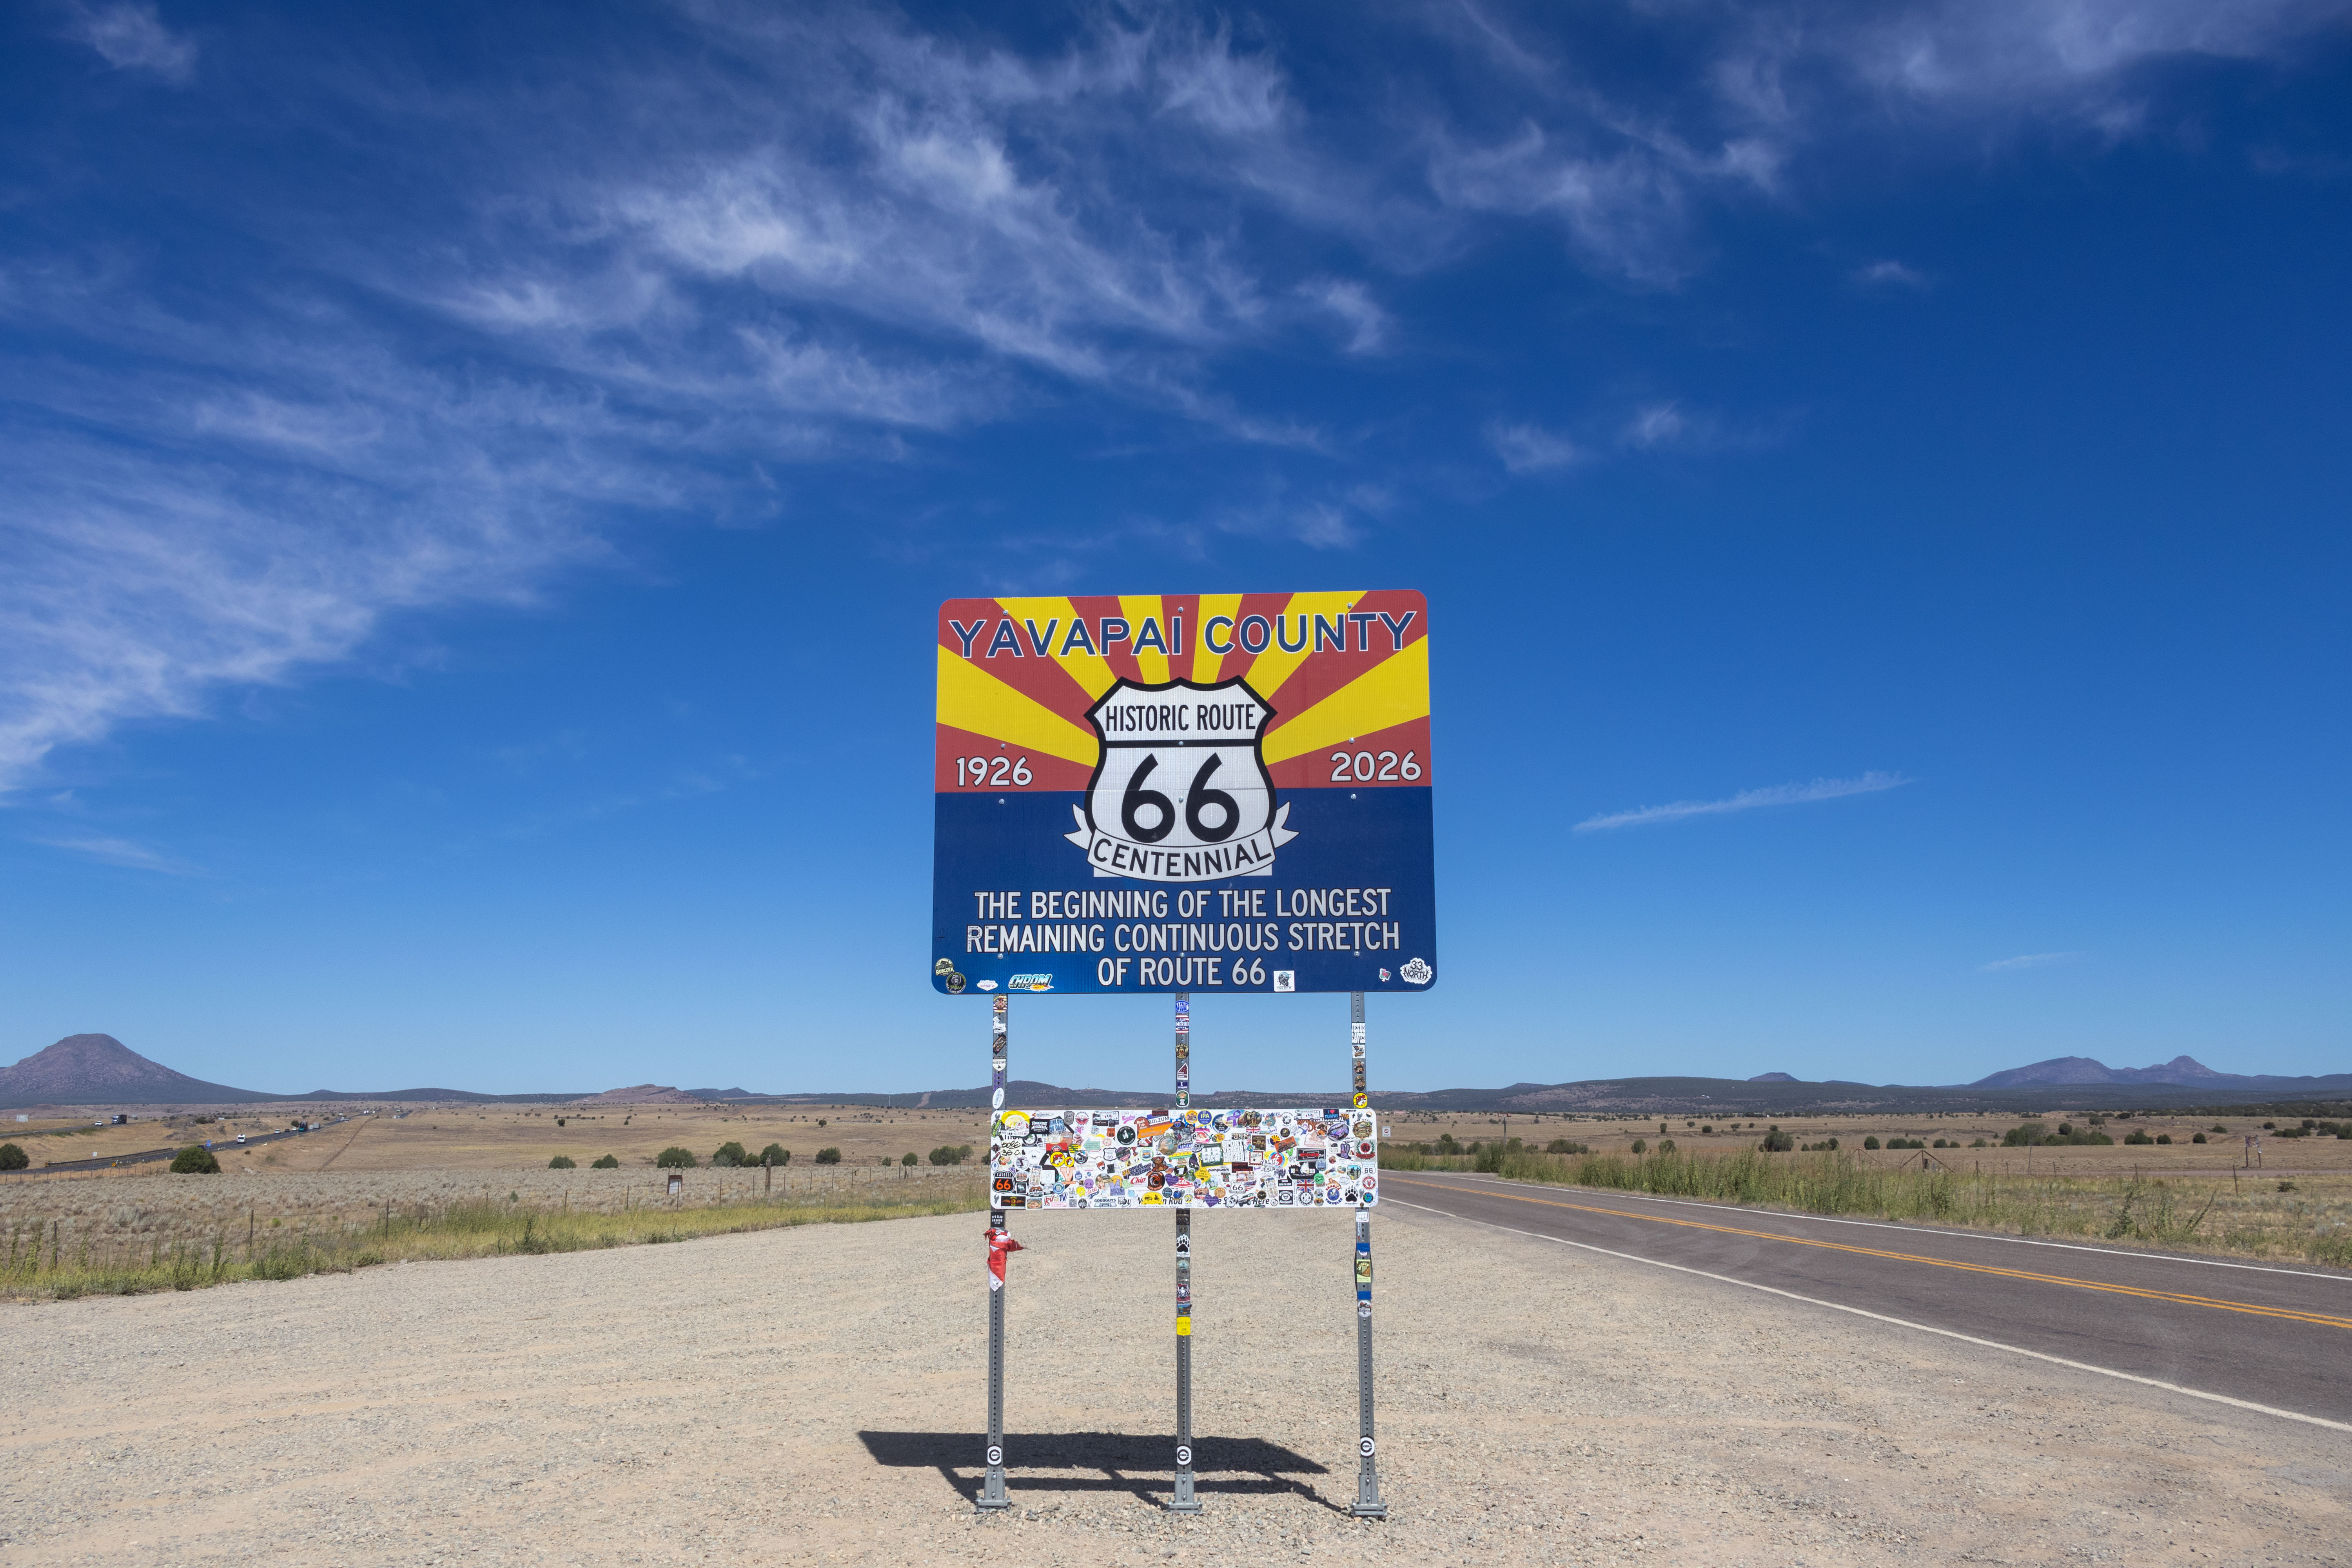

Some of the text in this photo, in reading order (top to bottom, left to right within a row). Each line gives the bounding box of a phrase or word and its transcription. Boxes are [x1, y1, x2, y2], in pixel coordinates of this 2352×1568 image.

[949, 611, 1417, 658] YAVAPAI COUNTY
[1105, 704, 1256, 732] HISTORIC ROUTE
[955, 755, 1033, 787] 1926
[1330, 750, 1422, 782] 2026
[1121, 752, 1240, 844] 66
[1093, 838, 1272, 877] CENTENNIAL
[973, 887, 1392, 920] THE BEGINNING OF THE LONGEST
[966, 924, 1102, 954] REMAINING
[1113, 923, 1279, 953] CONTINUOUS
[1283, 921, 1400, 951] STRETCH
[1410, 960, 1423, 970] 33
[936, 967, 955, 976] ROBCZEK
[1097, 957, 1267, 987] OF ROUTE 66
[1403, 967, 1429, 980] NORTH
[1352, 1023, 1365, 1033] JESUS
[1352, 1033, 1365, 1044] SAVES
[1149, 1116, 1169, 1124] BOLZUM
[1203, 1154, 1221, 1163] CREW
[1130, 1163, 1152, 1174] ELECTRIC
[1131, 1168, 1152, 1176] ARIZONA
[996, 1179, 1011, 1190] 66
[1131, 1176, 1146, 1185] Chip
[1059, 1193, 1067, 1202] TV
